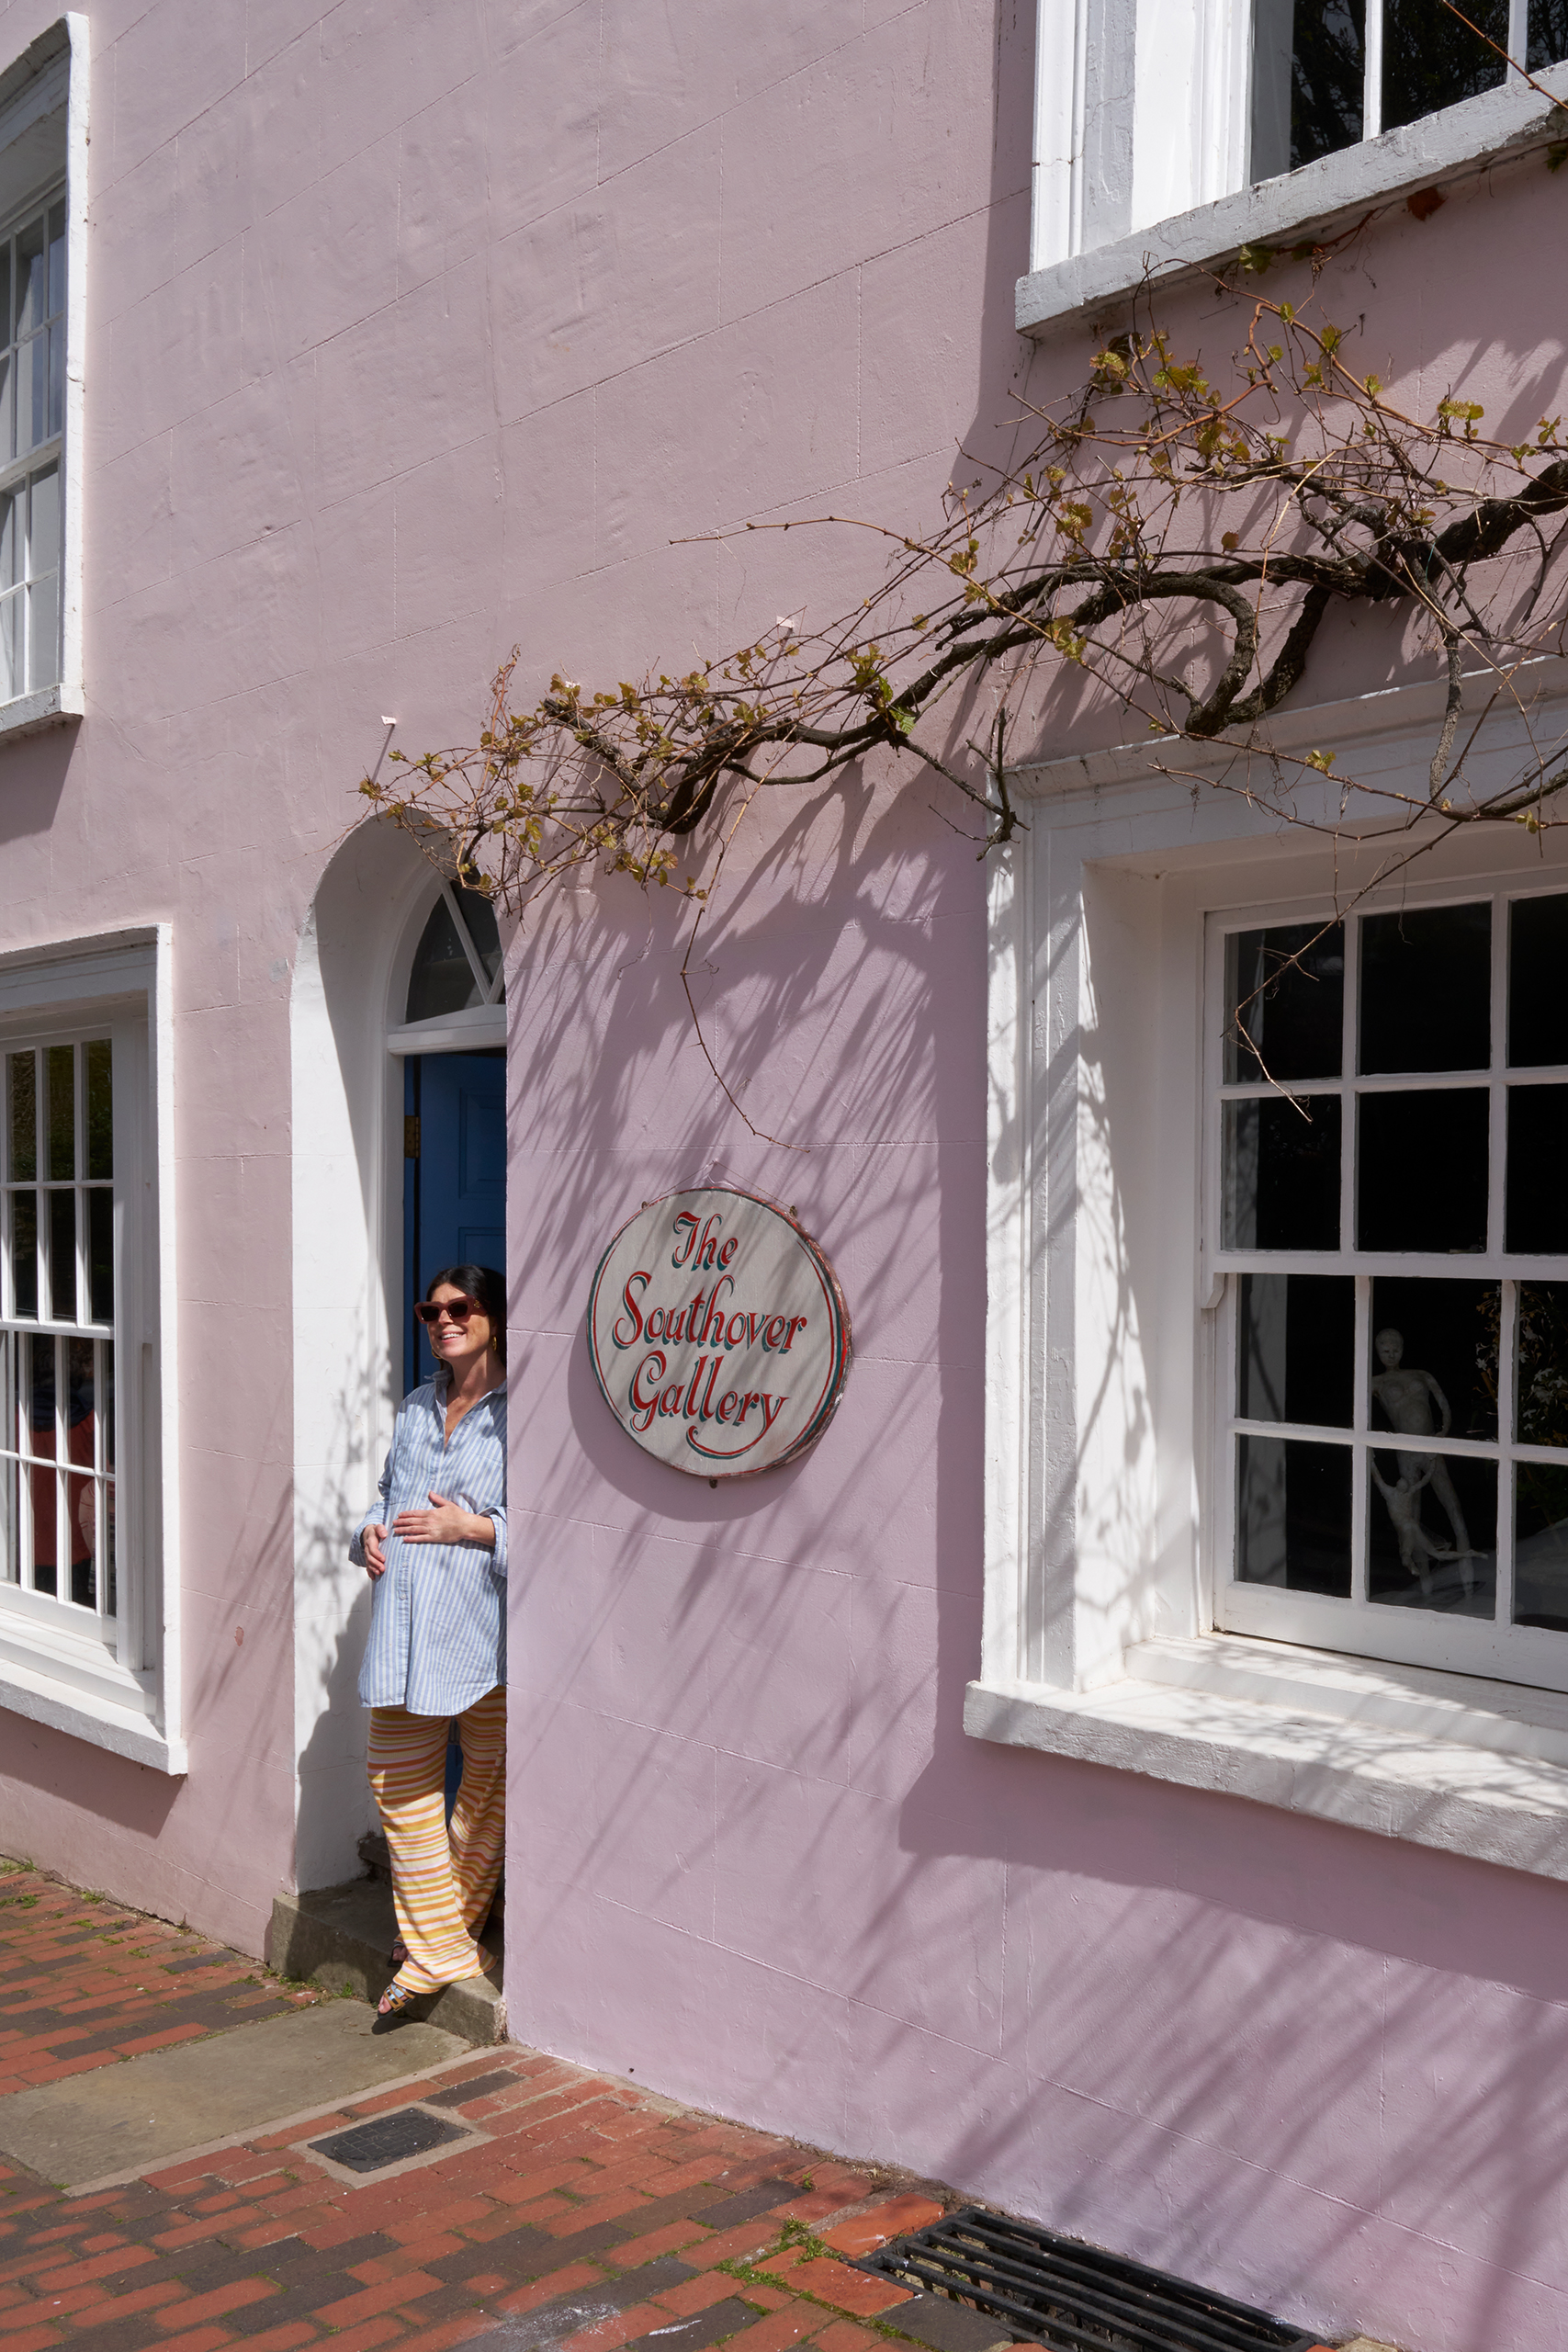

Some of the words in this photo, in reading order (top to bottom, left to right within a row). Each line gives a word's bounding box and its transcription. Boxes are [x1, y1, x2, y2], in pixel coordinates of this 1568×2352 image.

[671, 1211, 739, 1272] The
[612, 1271, 807, 1354] Southover
[628, 1350, 789, 1460] Gallery
